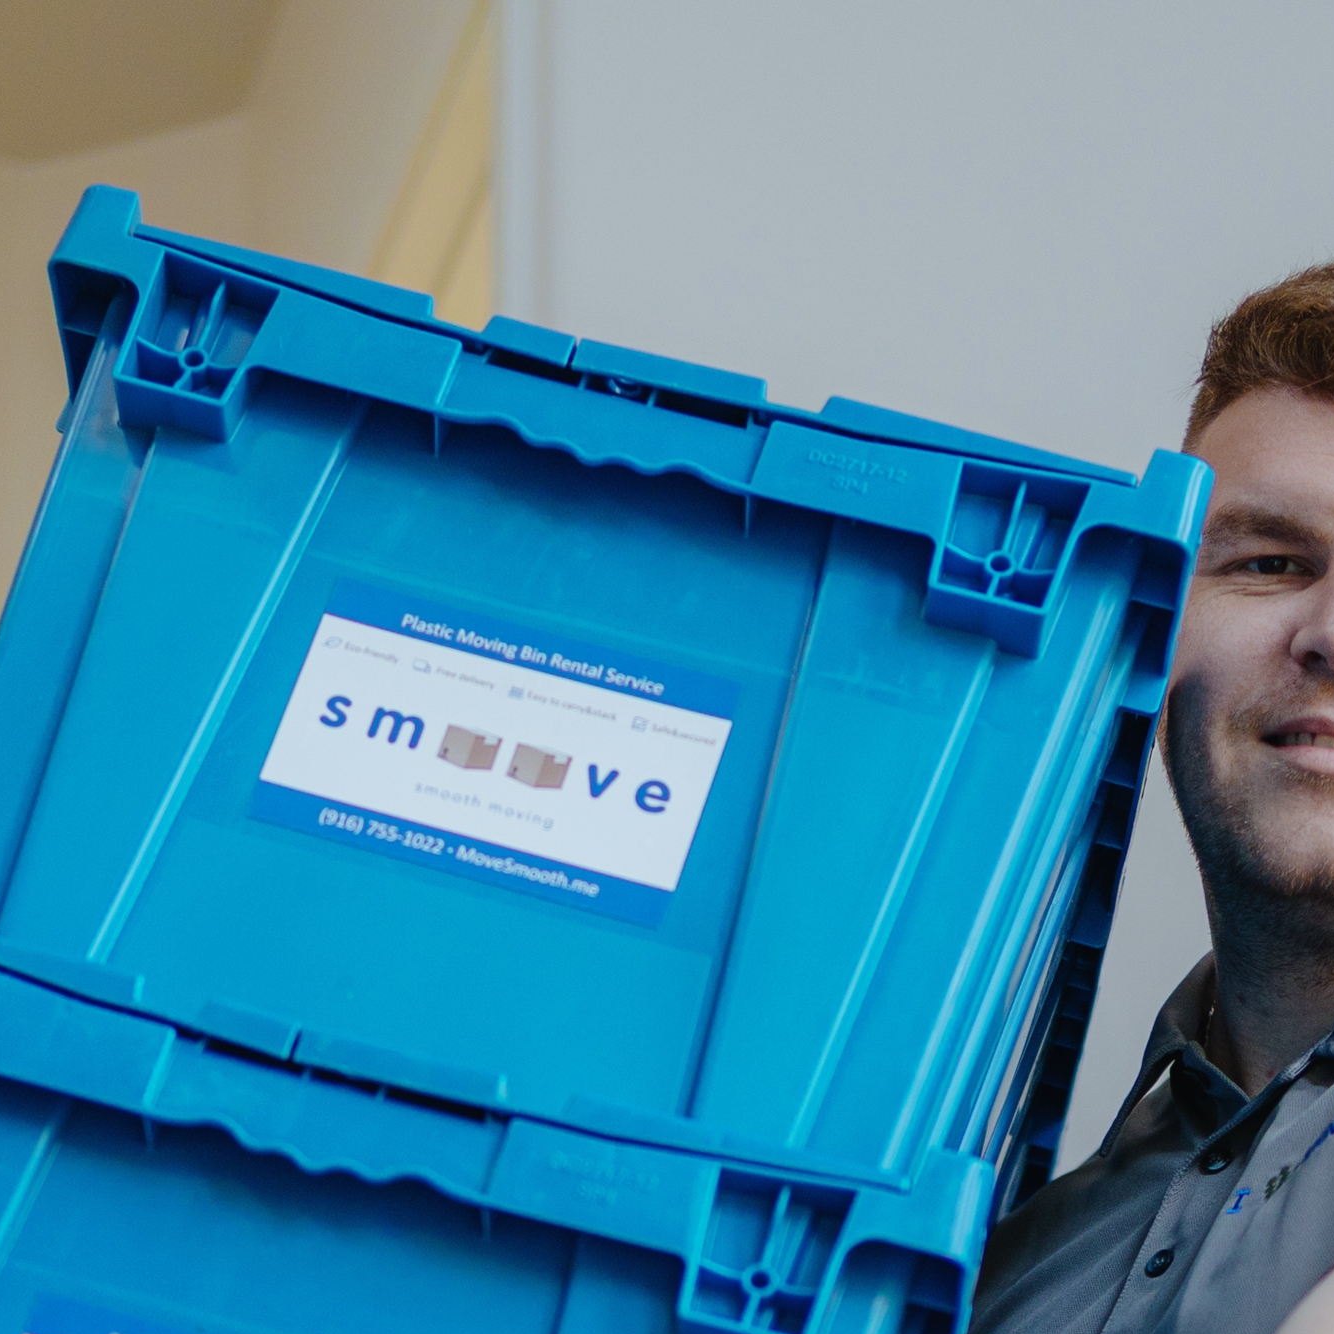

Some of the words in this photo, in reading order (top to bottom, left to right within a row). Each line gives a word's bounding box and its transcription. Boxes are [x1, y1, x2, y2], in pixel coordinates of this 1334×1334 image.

[401, 613, 453, 640] Plastic
[456, 628, 517, 660] Moving
[520, 645, 547, 665] Bin
[550, 653, 603, 680] Rental
[605, 667, 665, 696] Service
[415, 782, 482, 808] smooth
[488, 802, 555, 831] moving
[318, 806, 365, 835] (916)
[366, 819, 445, 855] 755-1022
[455, 844, 600, 897] MoveSmooth.me
